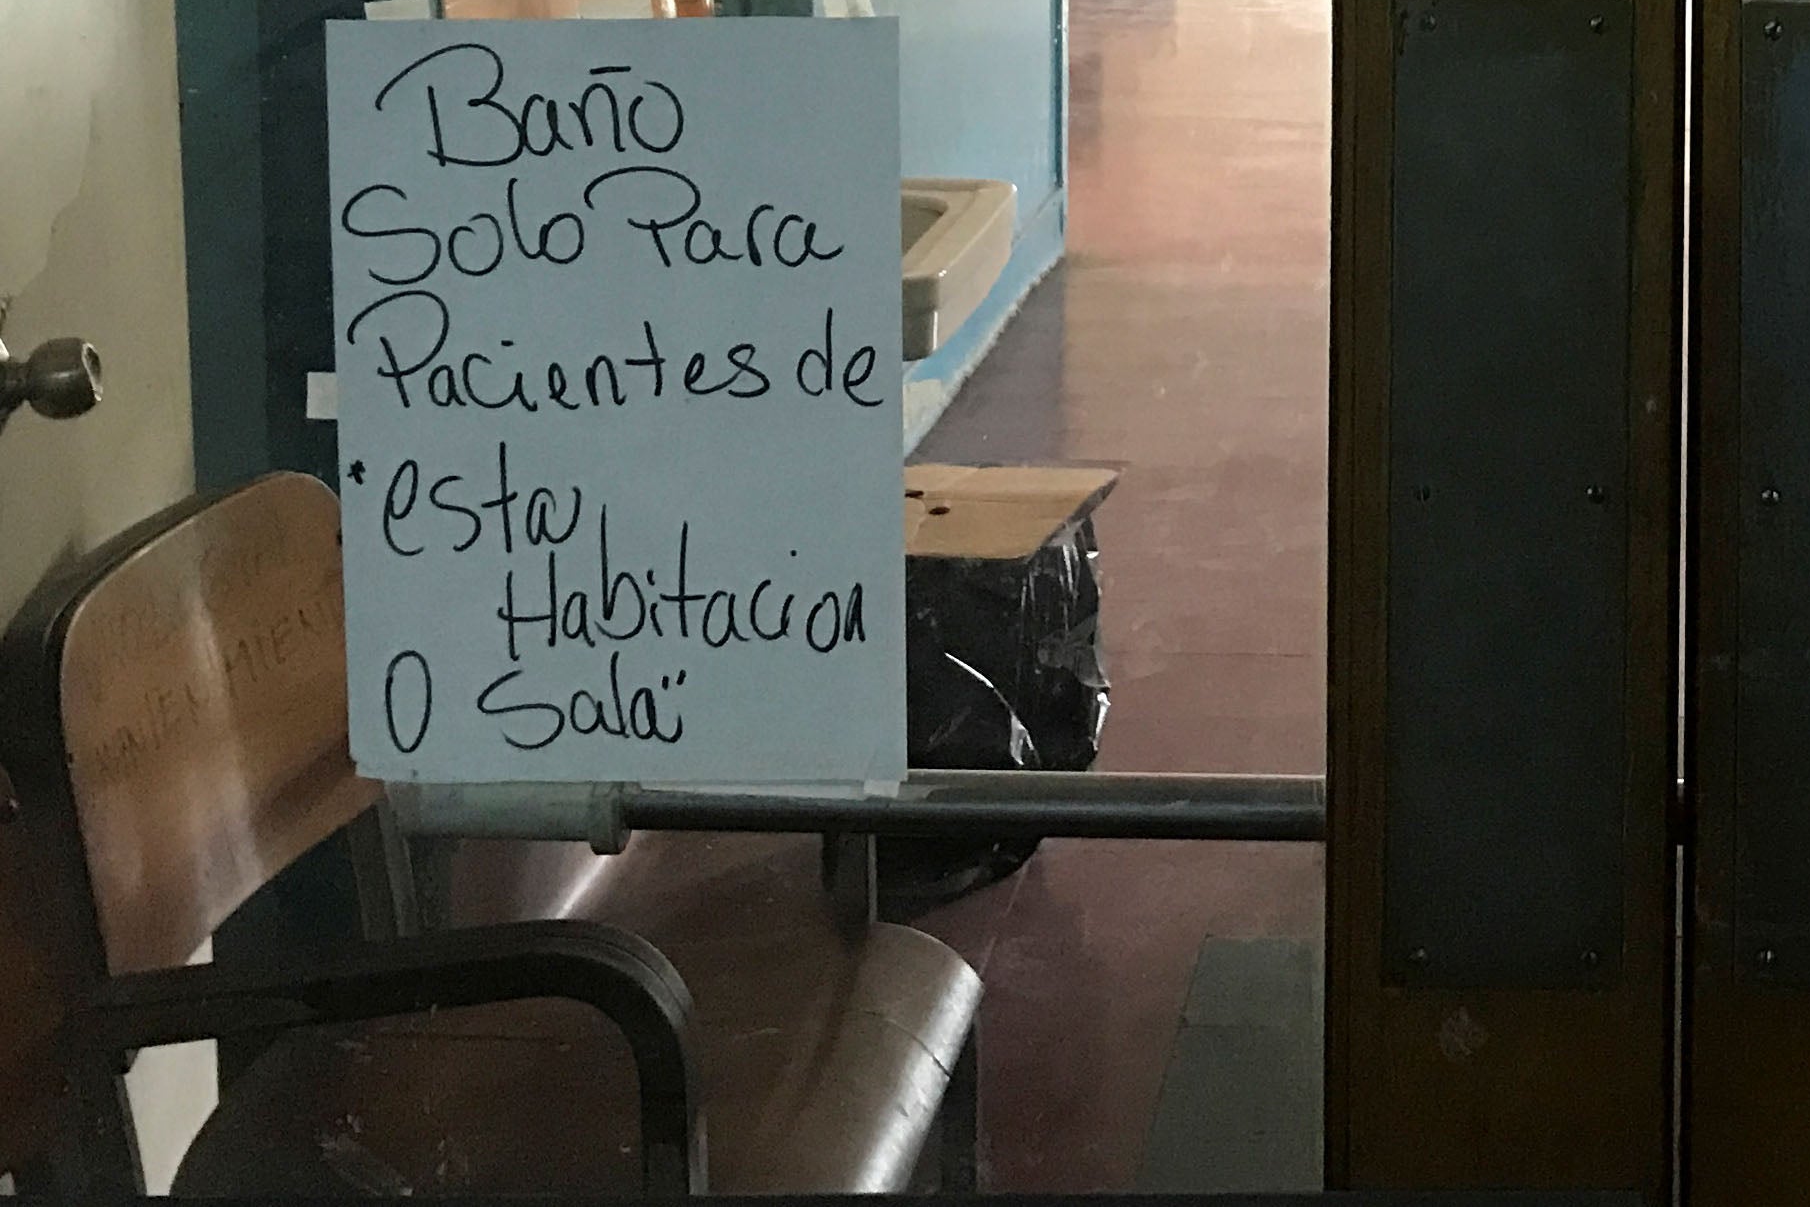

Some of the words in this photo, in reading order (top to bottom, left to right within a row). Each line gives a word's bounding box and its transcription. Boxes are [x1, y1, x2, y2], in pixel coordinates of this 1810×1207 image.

[375, 43, 686, 167] Baño
[342, 178, 585, 285] Solo
[584, 165, 845, 268] Para
[347, 290, 771, 411] Pacientes
[798, 307, 885, 407] de
[497, 503, 866, 661] Habitacion
